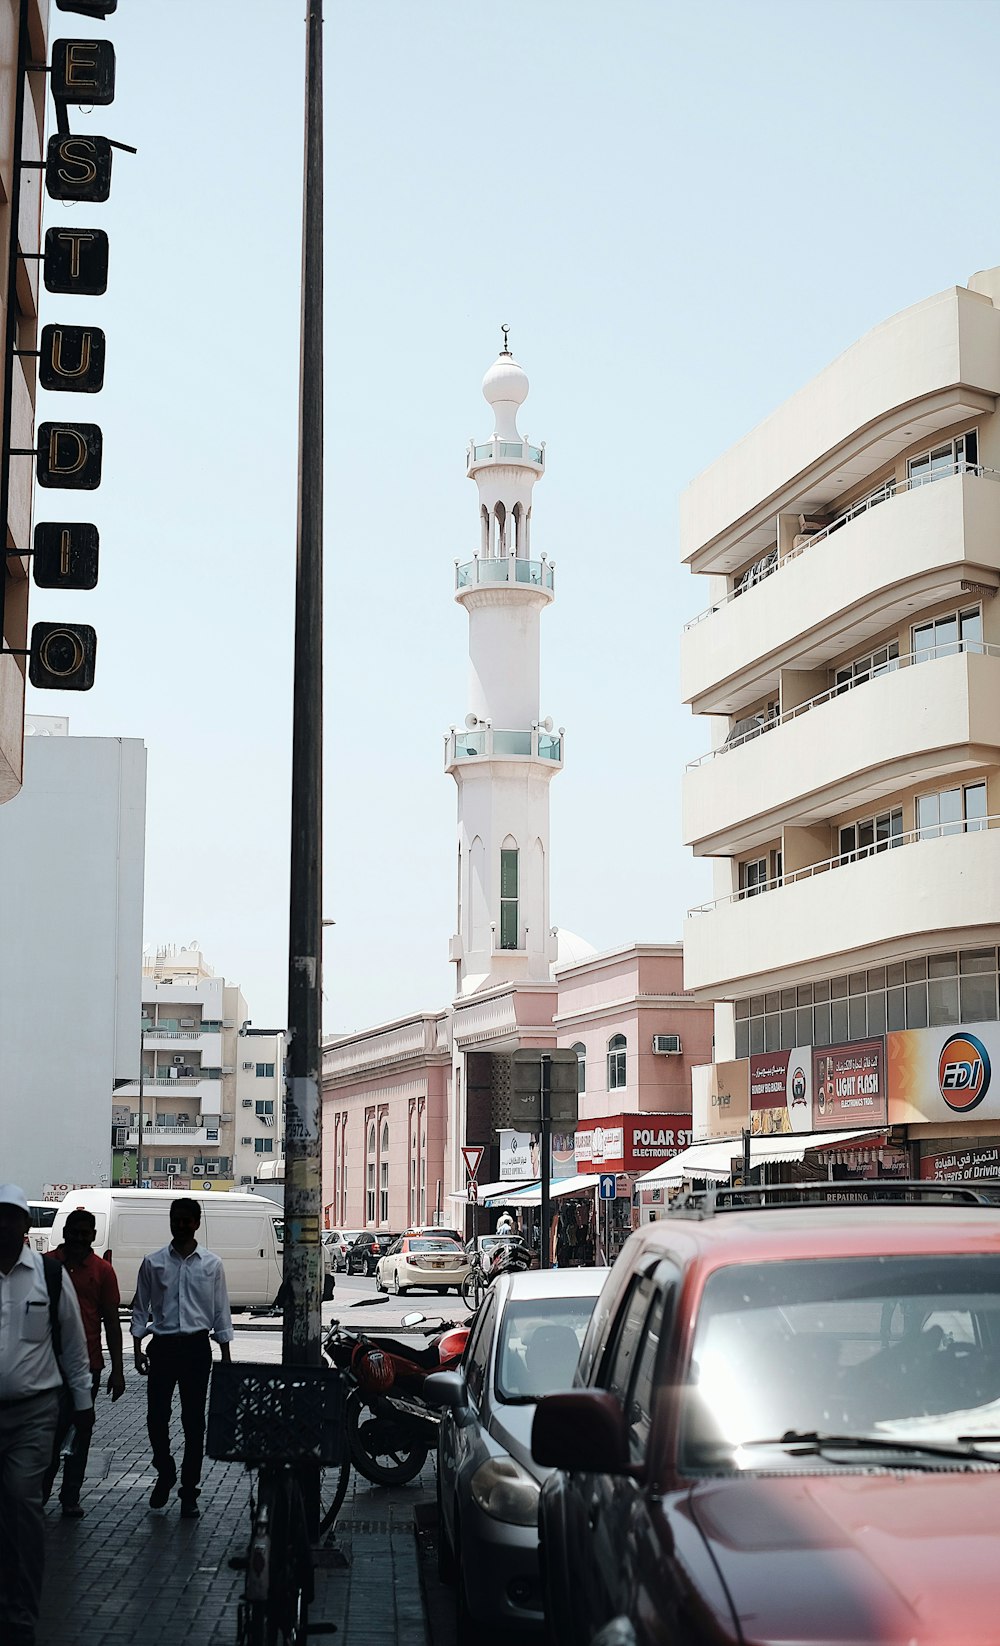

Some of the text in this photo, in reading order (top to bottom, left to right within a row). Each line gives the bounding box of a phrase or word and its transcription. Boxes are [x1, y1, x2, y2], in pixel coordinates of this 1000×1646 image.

[942, 1059, 980, 1090] EDI
[836, 1073, 879, 1097] LIGHT FLASH
[841, 1098, 863, 1108] ELECTRONICS
[633, 1129, 675, 1146] POLAR
[632, 1148, 677, 1157] ELECTRONICS
[934, 1149, 998, 1170] التميز في القيادة
[934, 1171, 943, 1181] 25
[944, 1170, 963, 1182] years
[964, 1167, 973, 1179] of
[826, 1192, 868, 1202] REPAIRING
